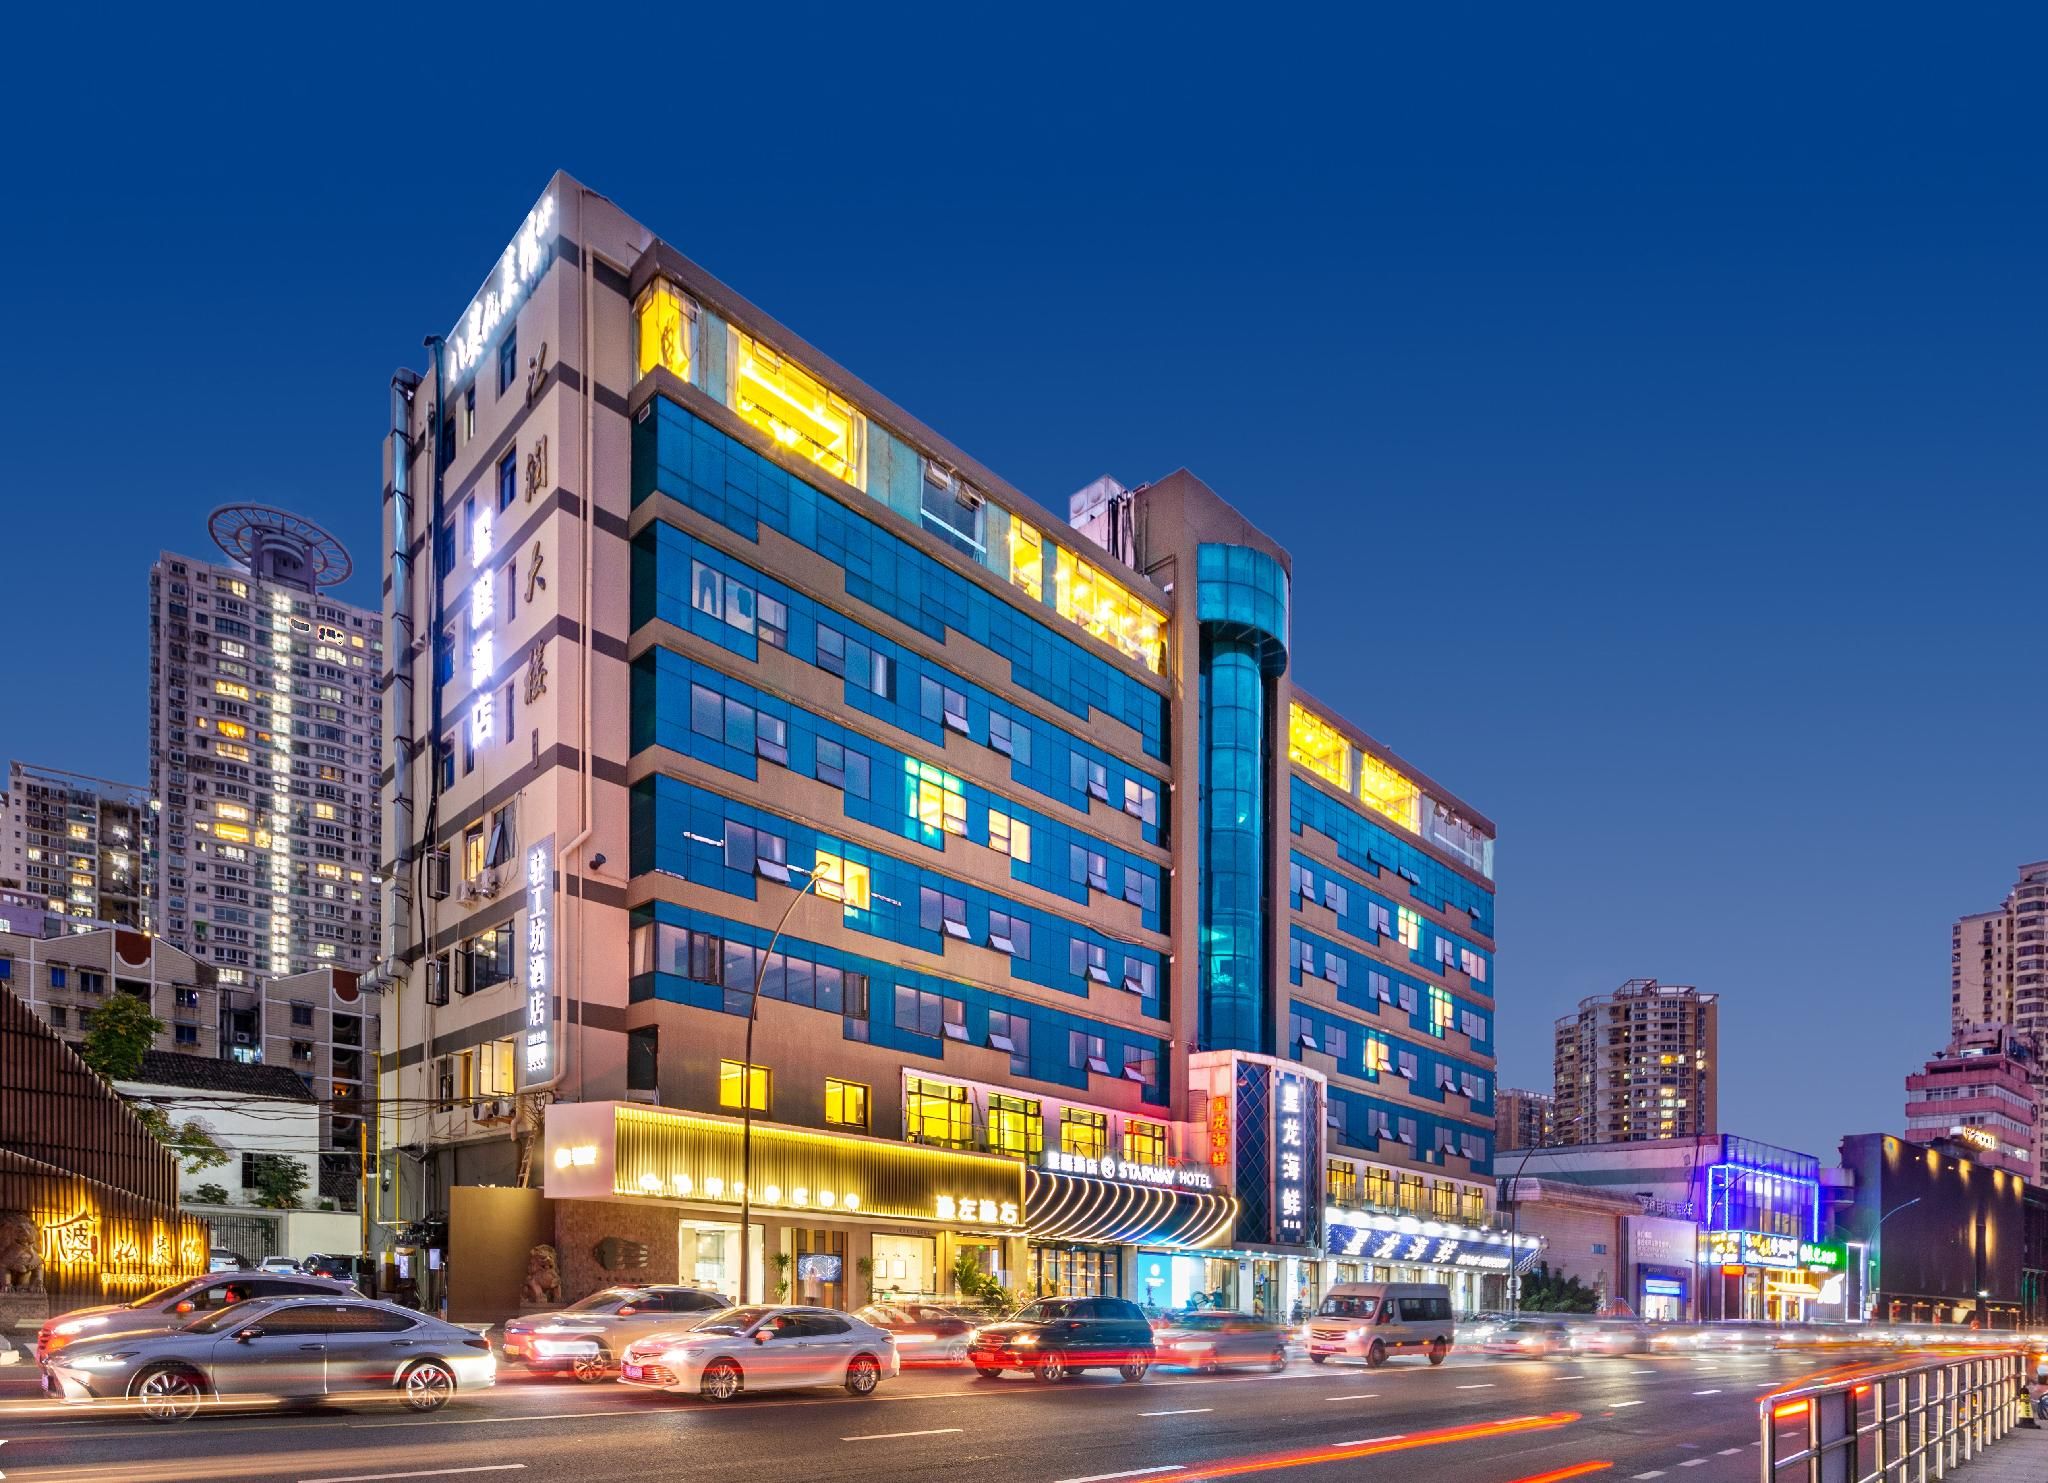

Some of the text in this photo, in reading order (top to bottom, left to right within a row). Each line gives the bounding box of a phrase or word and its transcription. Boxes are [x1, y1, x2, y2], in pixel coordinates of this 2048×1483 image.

[1118, 1162, 1175, 1184] STARWAY
[1179, 1171, 1212, 1188] HOTEL
[1283, 1085, 1301, 1215] 星龙海鲜
